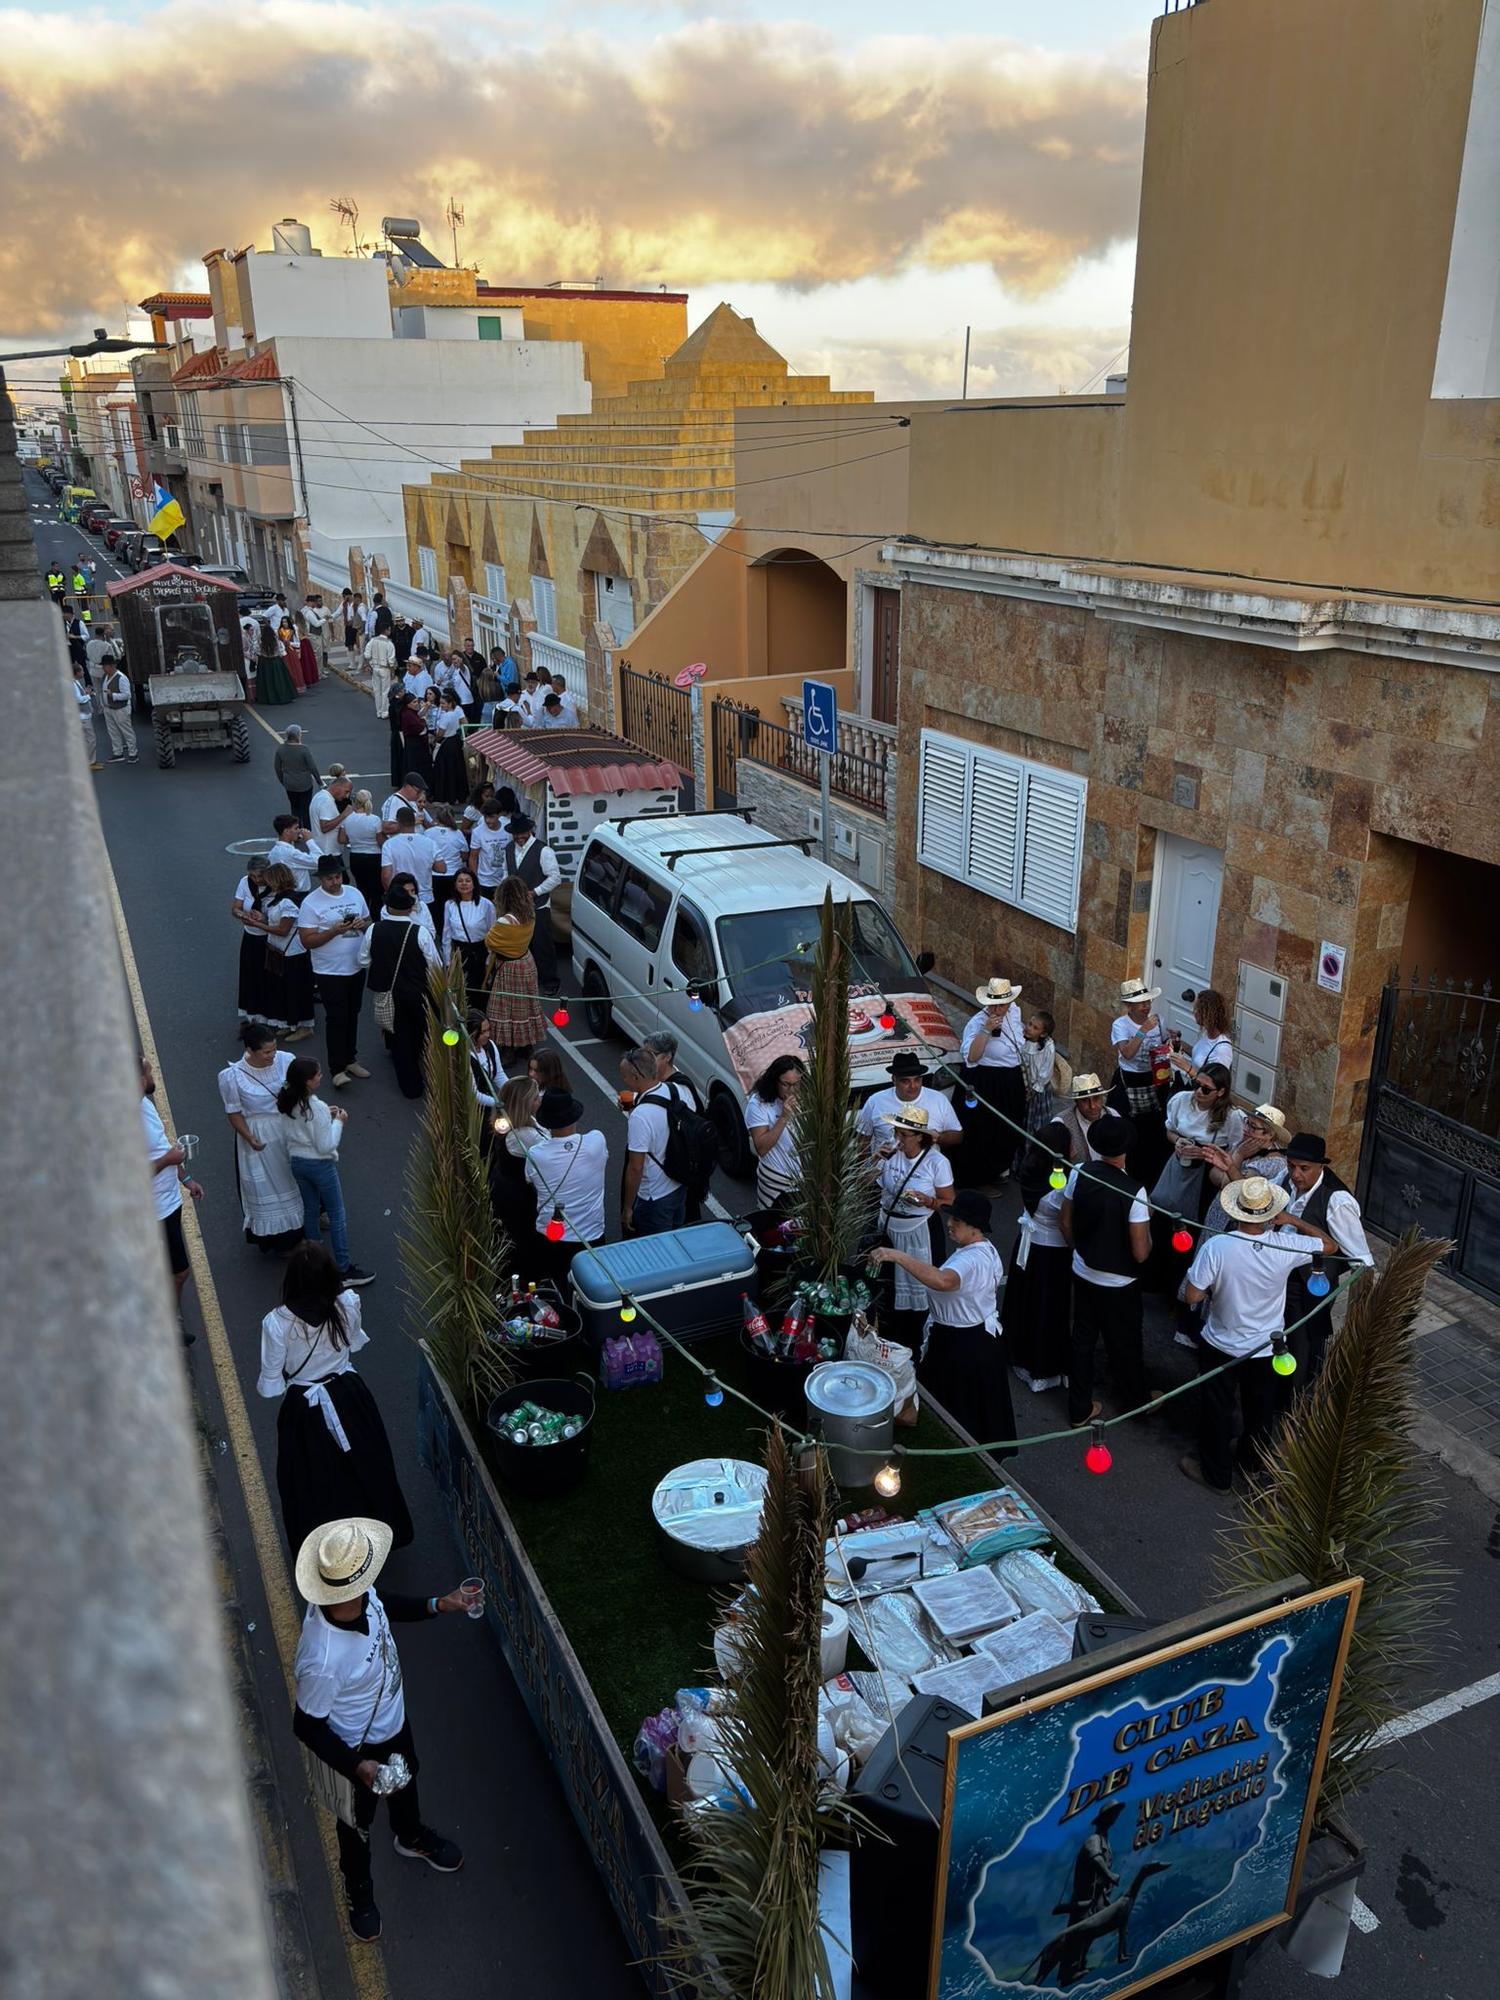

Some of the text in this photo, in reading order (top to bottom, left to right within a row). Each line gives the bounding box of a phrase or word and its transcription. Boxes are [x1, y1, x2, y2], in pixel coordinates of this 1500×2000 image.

[1113, 1685, 1225, 1753] CLUB
[1058, 1716, 1259, 1825] DE CAZA
[1137, 1752, 1270, 1826] Medianias
[1132, 1776, 1268, 1851] de Ingenio
